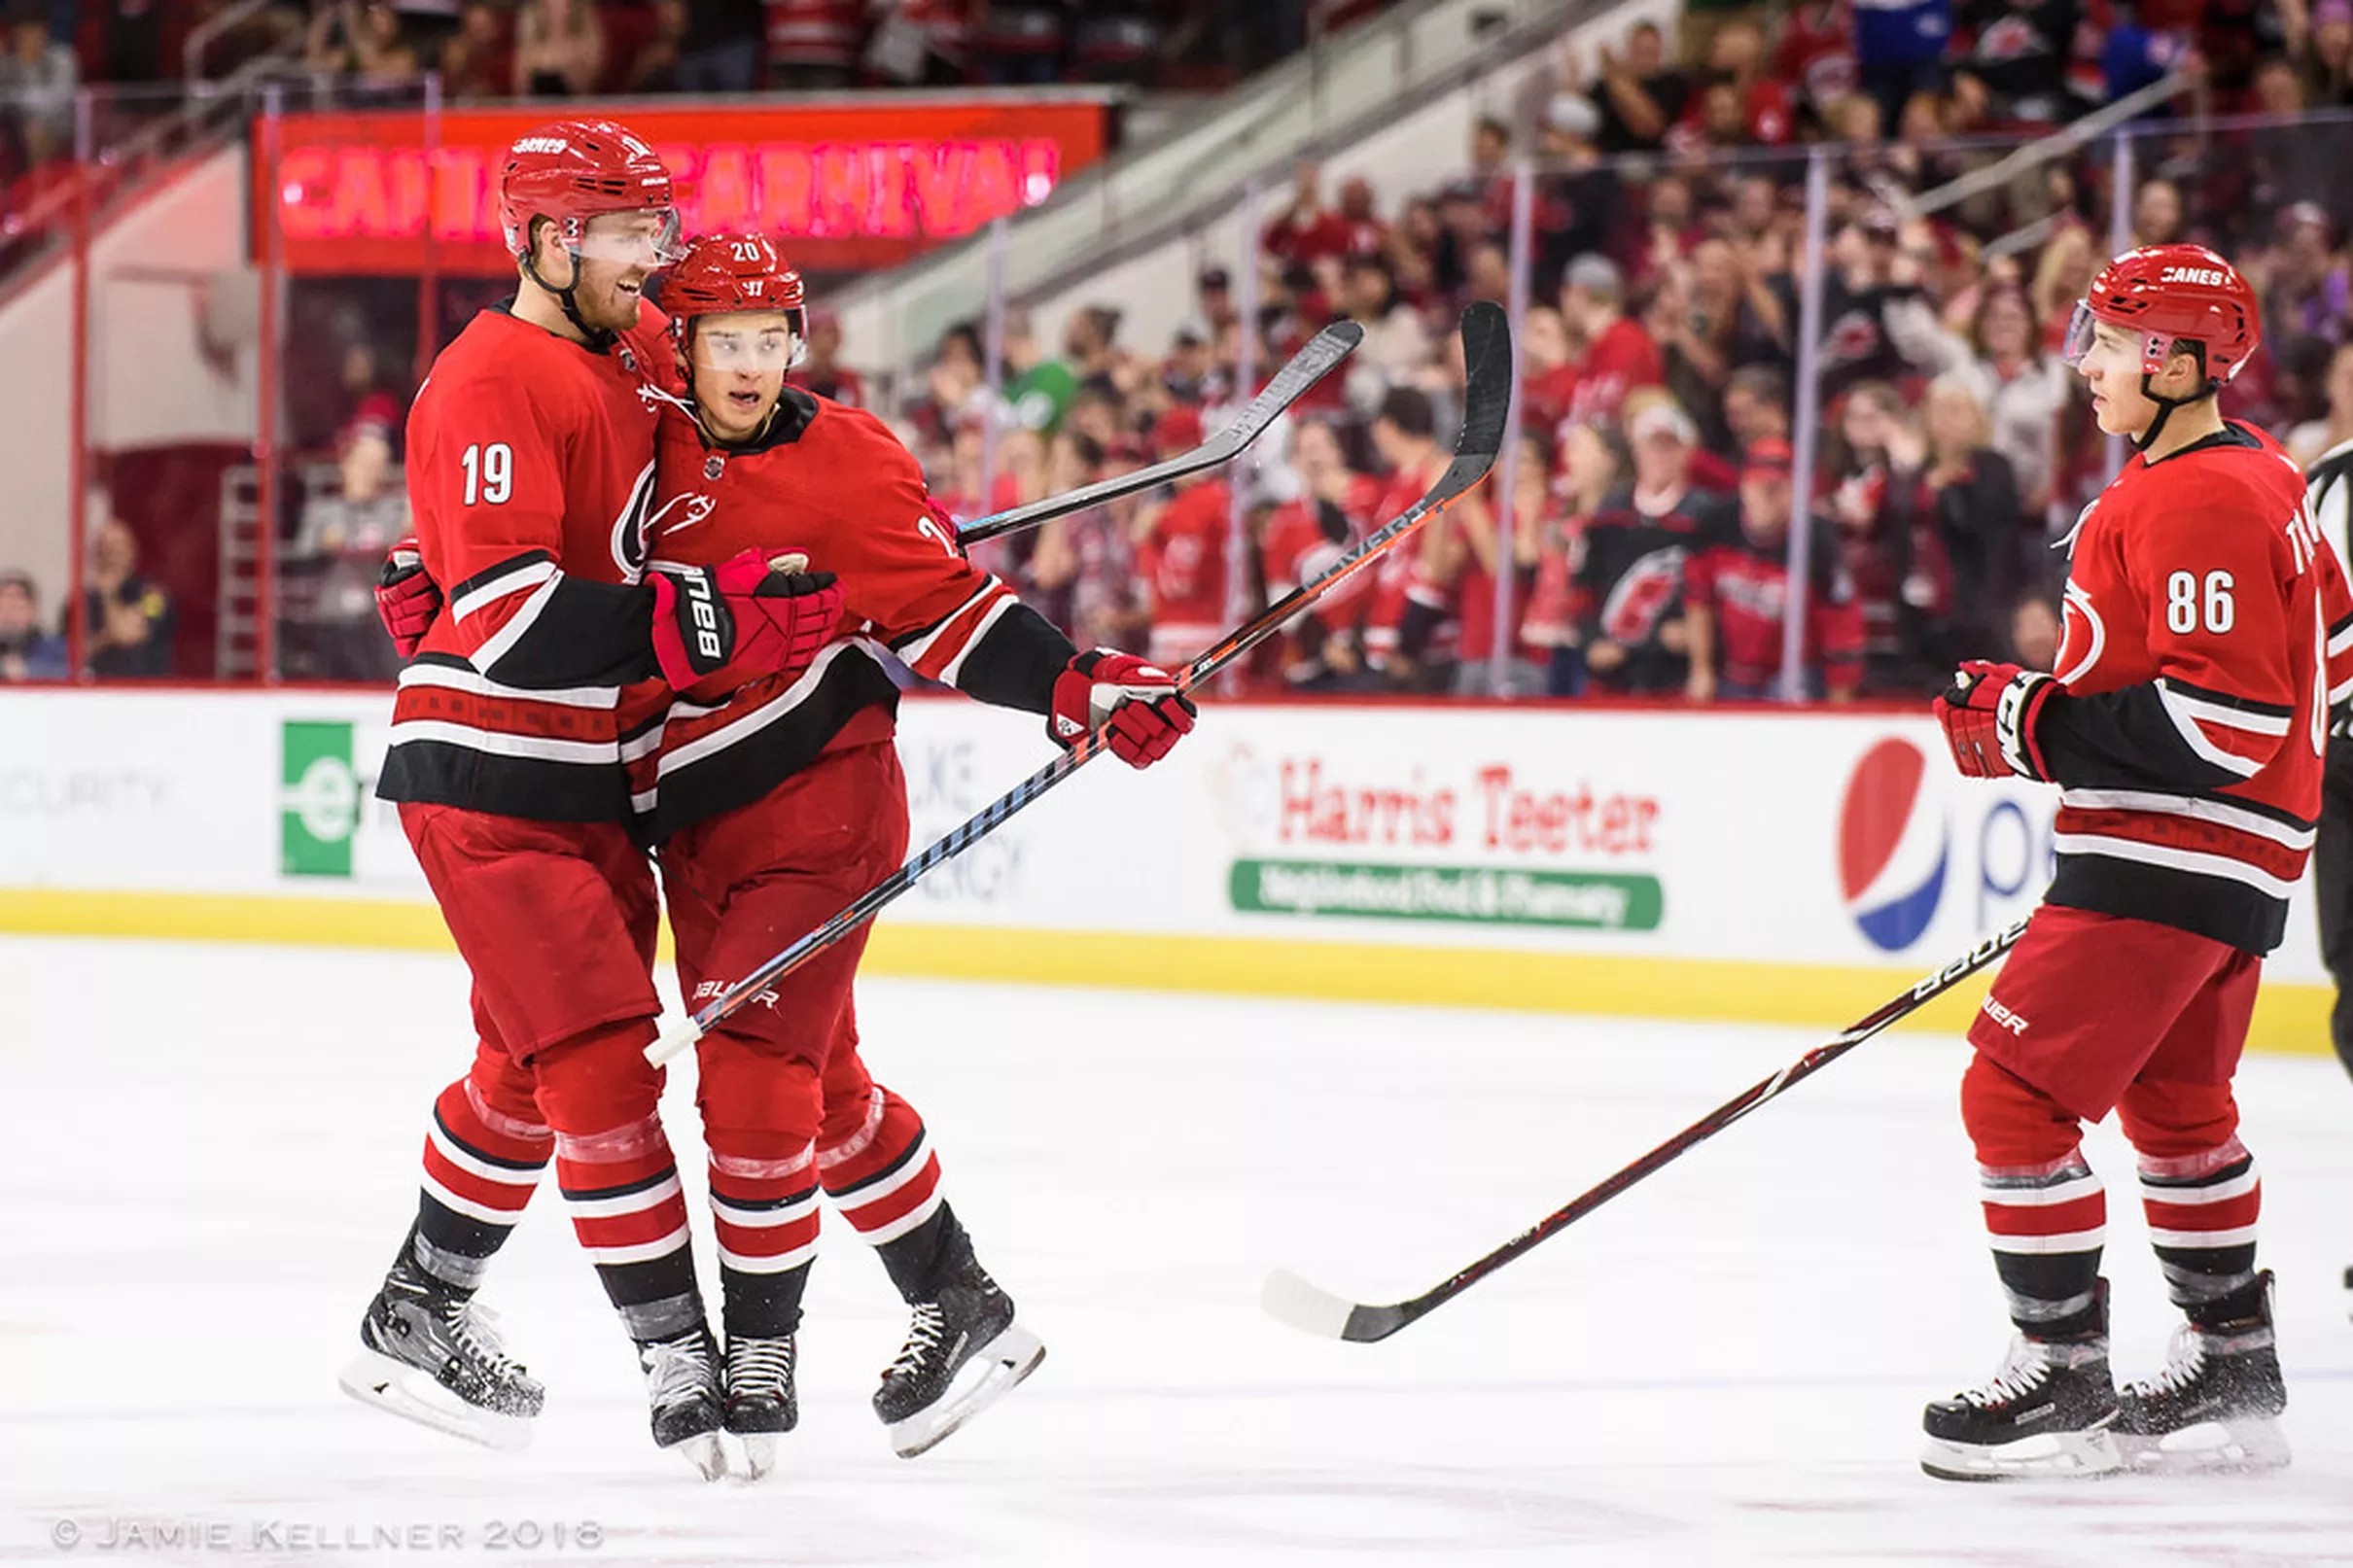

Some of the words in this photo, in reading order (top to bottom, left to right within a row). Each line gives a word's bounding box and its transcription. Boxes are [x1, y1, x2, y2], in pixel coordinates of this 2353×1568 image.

[730, 242, 760, 261] 20
[2160, 266, 2223, 287] CANES
[461, 442, 512, 505] 19
[2166, 570, 2235, 635] 86
[1280, 757, 1456, 844] Harris
[1476, 764, 1661, 855] Teeter
